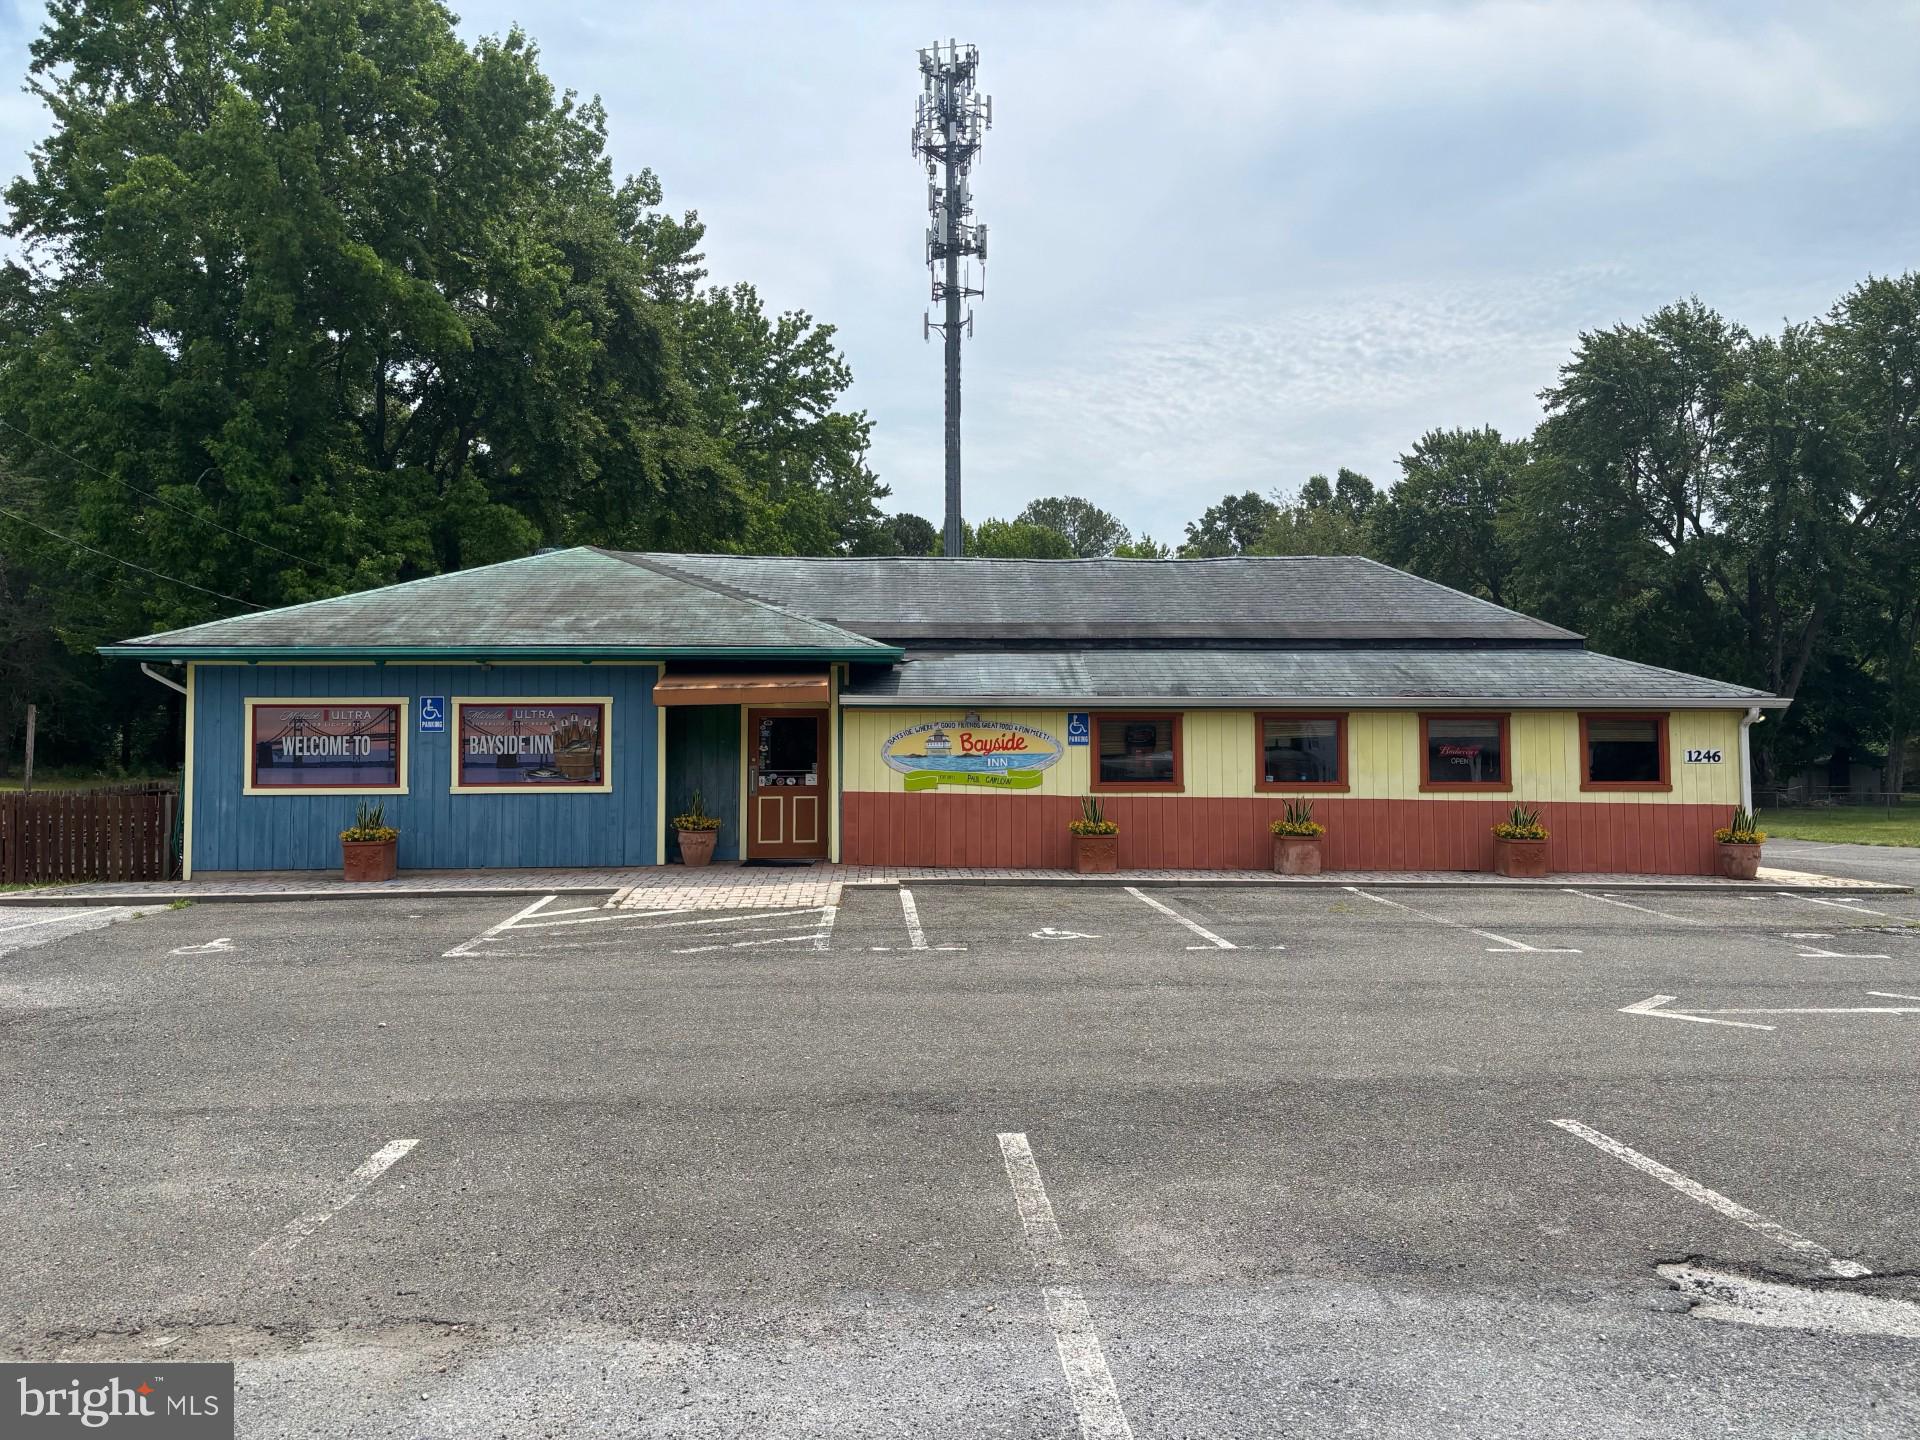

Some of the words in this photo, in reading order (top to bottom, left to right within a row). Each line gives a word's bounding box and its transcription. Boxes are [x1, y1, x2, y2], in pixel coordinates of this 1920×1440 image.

[331, 710, 372, 720] ULTRA
[515, 710, 556, 719] ULTRA
[888, 728, 913, 745] BAYSIDE
[981, 721, 998, 729] GREAT
[282, 736, 350, 756] WELCOME
[354, 736, 371, 756] TO
[469, 735, 526, 755] BAYSIDE
[530, 735, 554, 754] INN
[959, 732, 1029, 757] Bayside
[987, 758, 1008, 767] INN
[1450, 757, 1469, 765] OPEN
[1687, 750, 1721, 763] 1246
